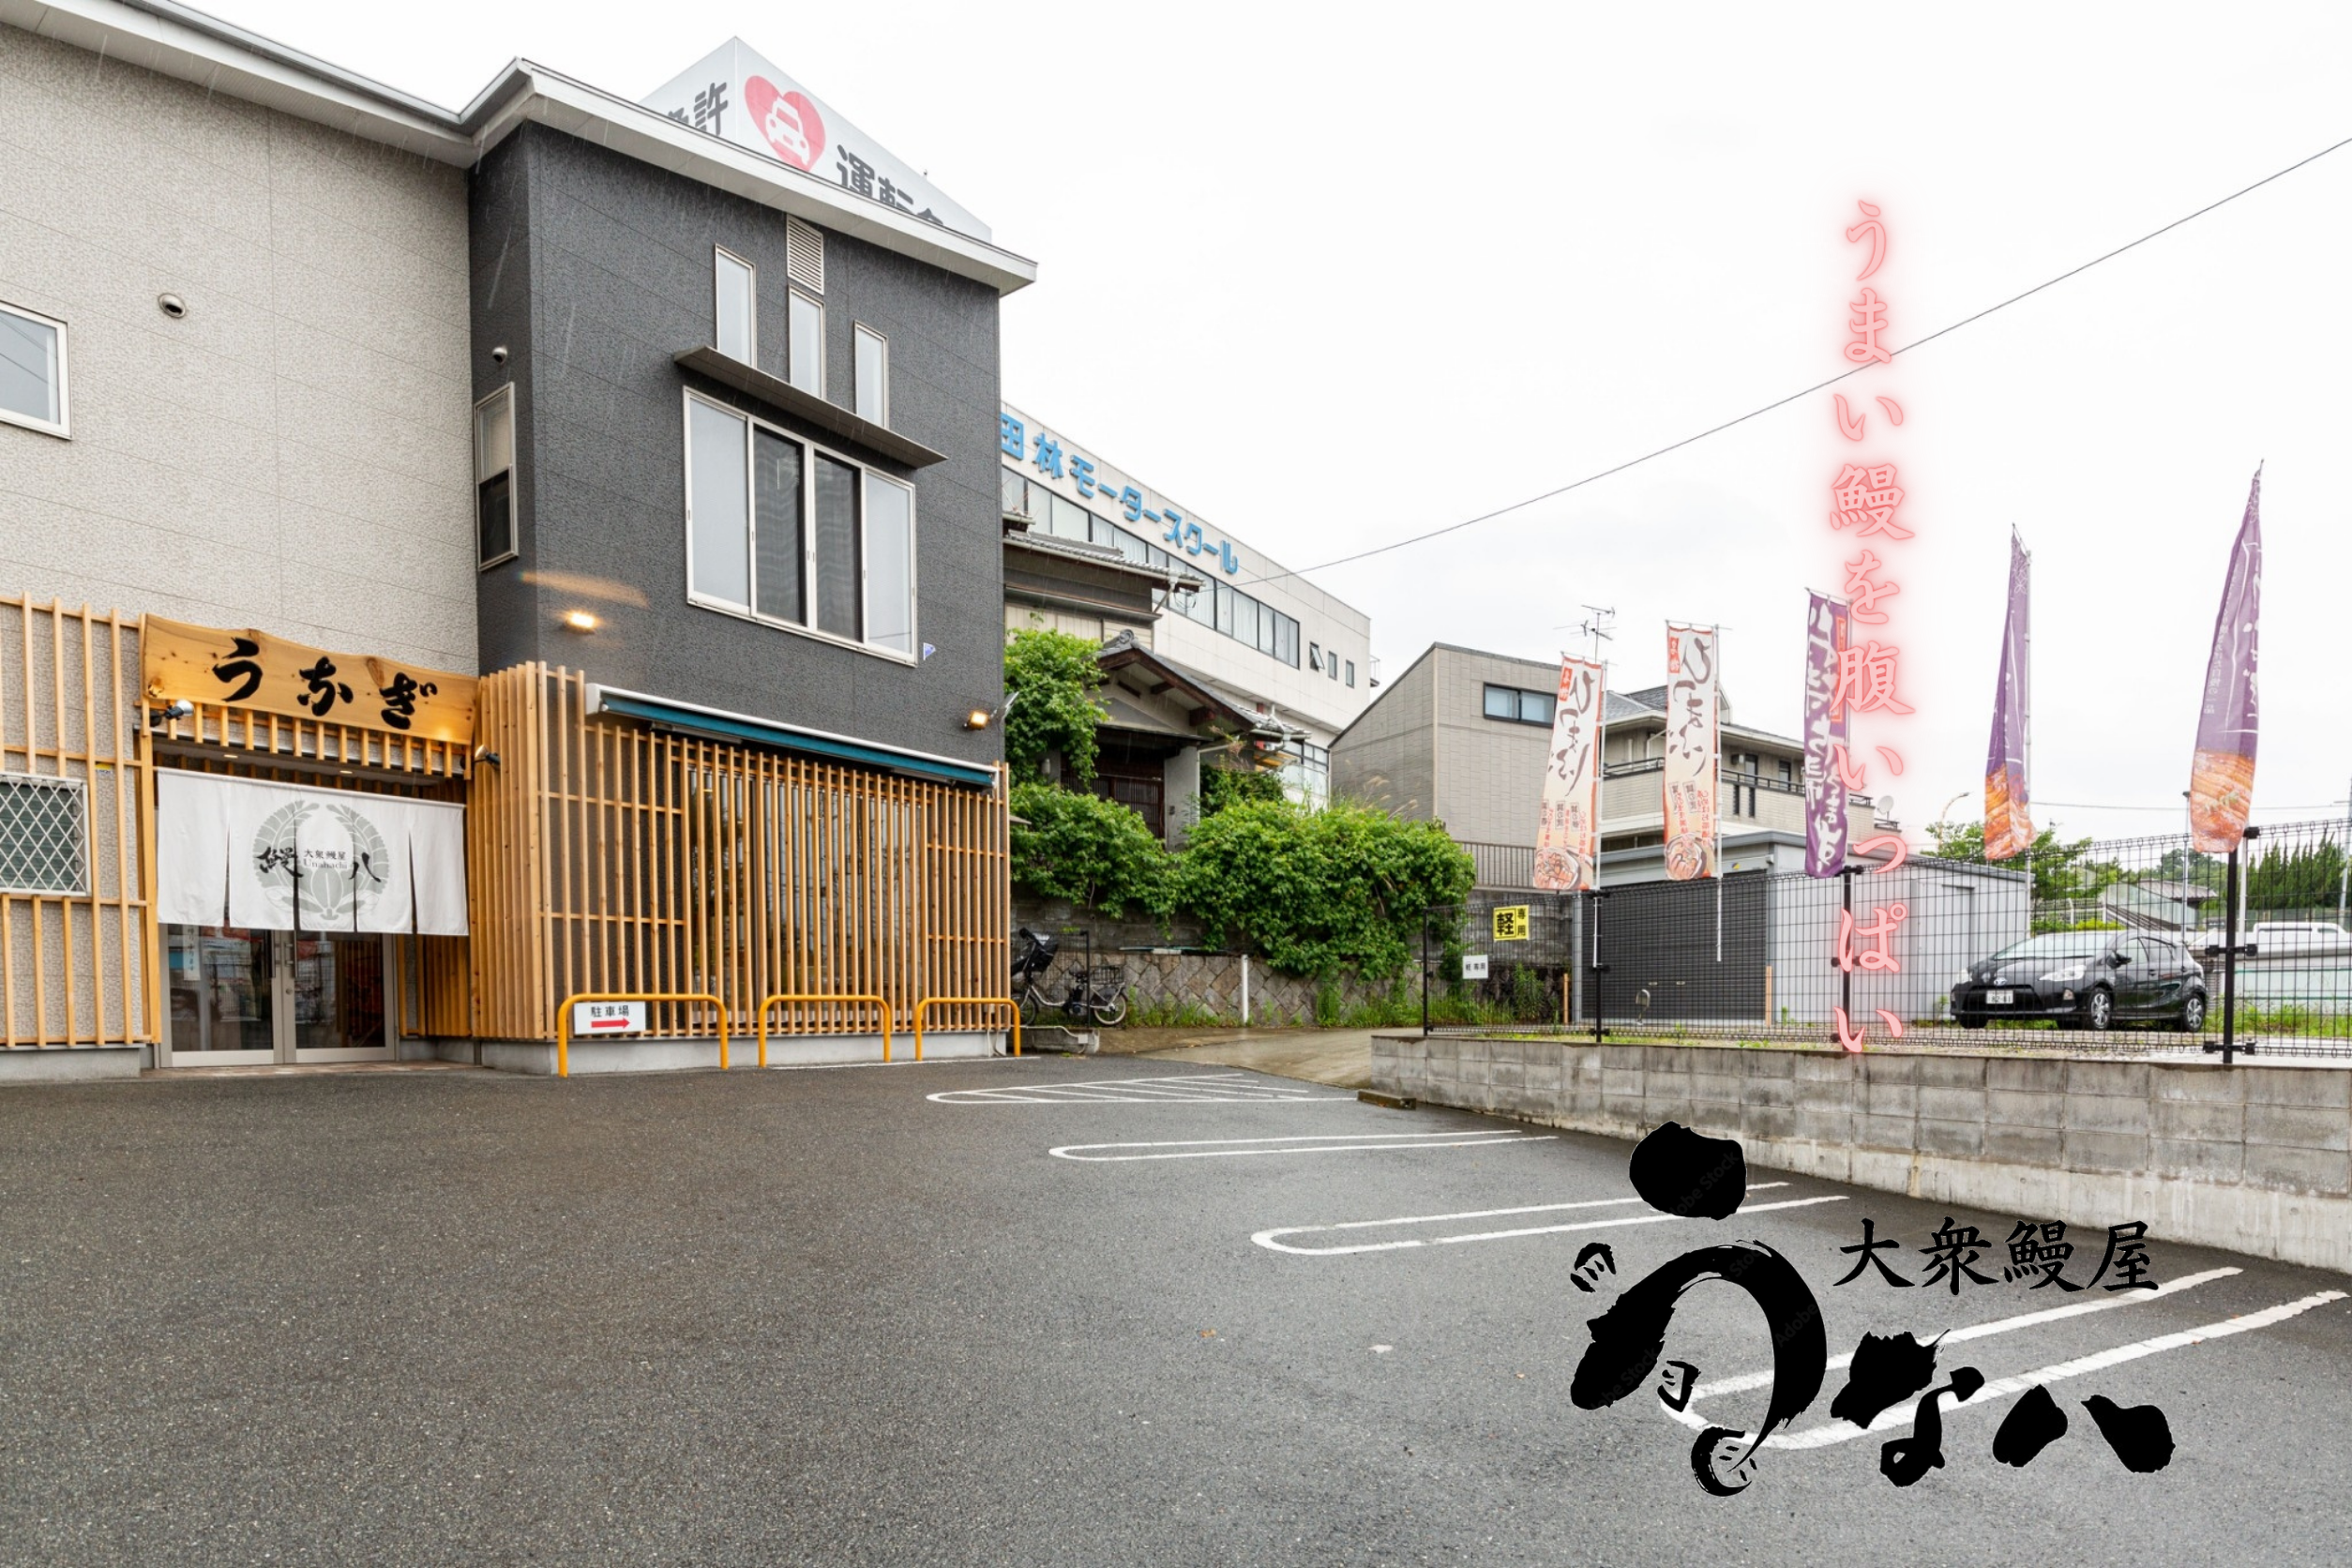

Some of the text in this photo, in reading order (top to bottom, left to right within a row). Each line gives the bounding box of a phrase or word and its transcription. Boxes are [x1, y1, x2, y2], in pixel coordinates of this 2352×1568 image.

[212, 636, 438, 730] うなぎ
[1497, 912, 1515, 935] 軽
[1517, 908, 1526, 936] 専用
[591, 1005, 629, 1018] 駐車場
